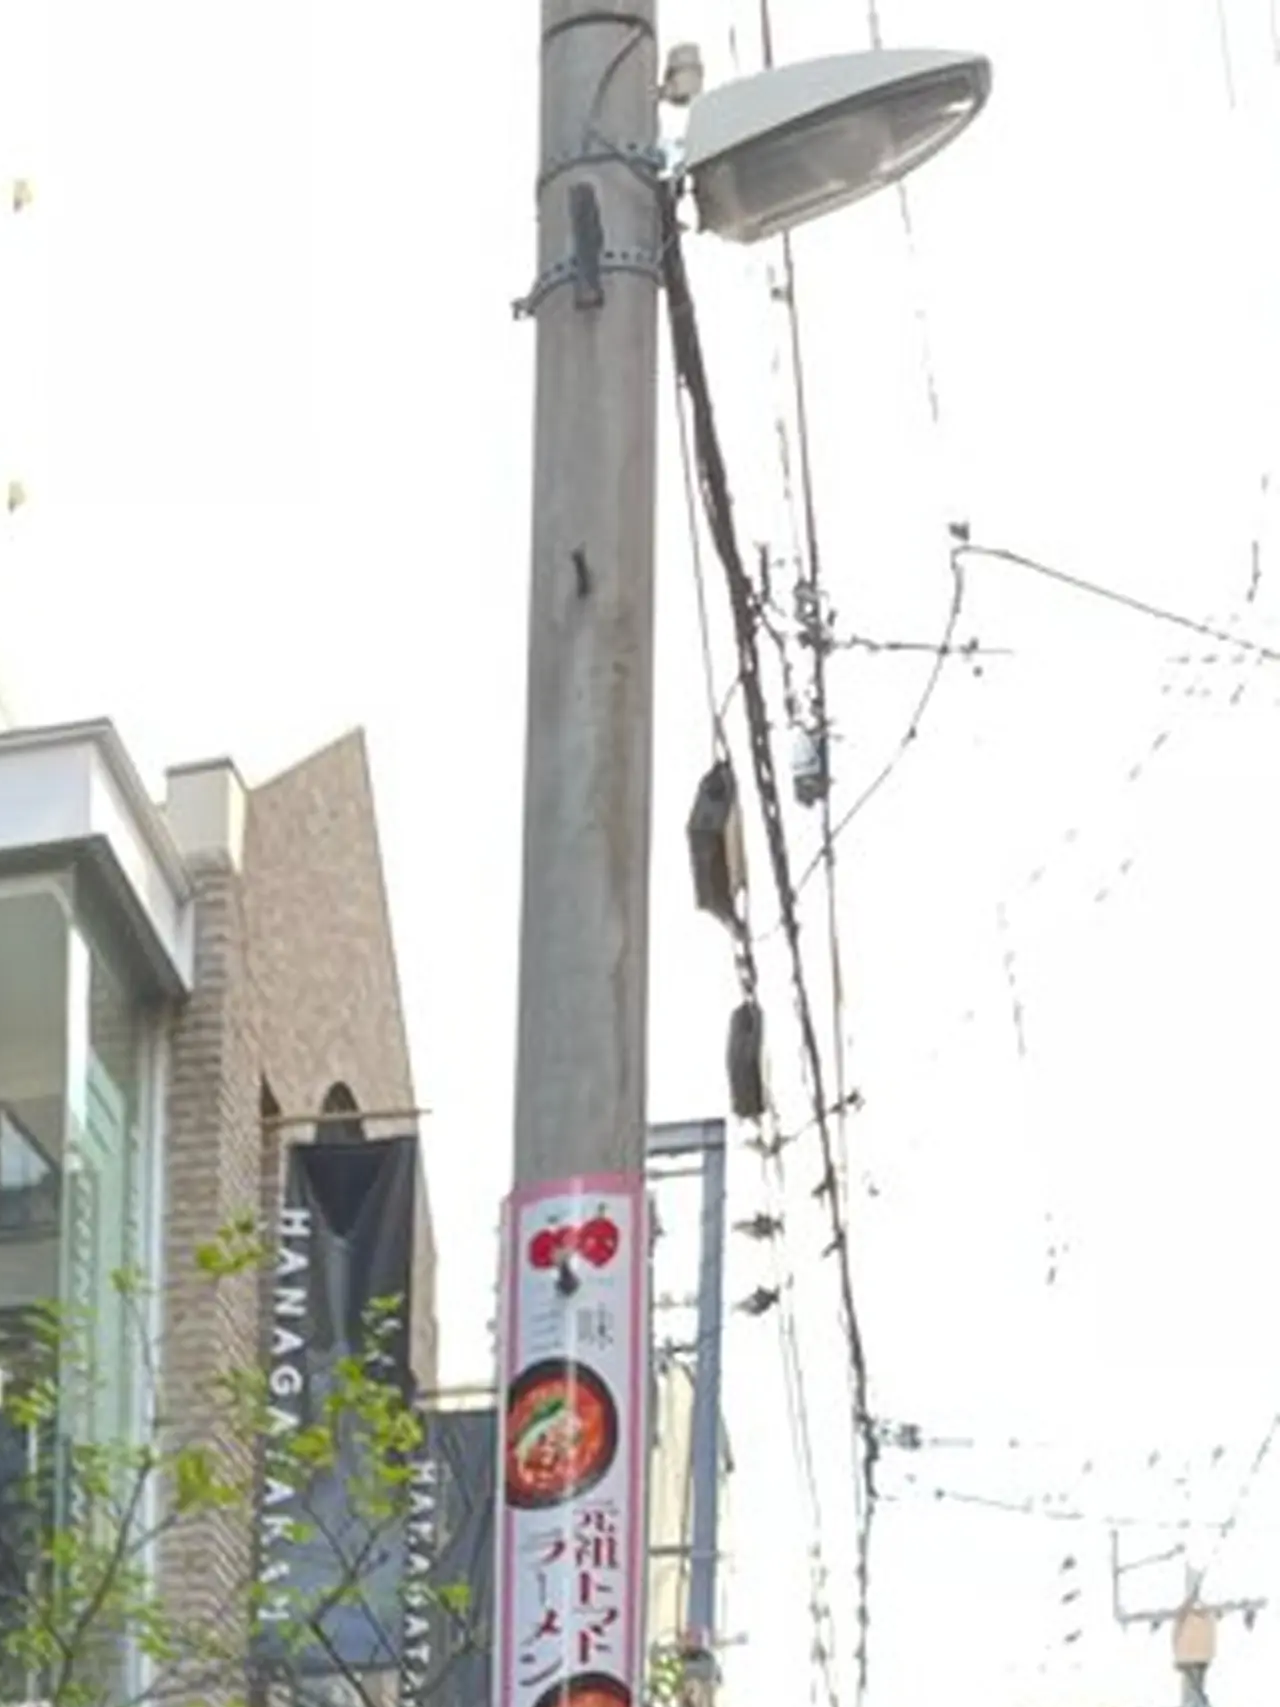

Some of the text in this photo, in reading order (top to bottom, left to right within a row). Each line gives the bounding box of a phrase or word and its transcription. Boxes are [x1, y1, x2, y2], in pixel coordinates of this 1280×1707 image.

[520, 1527, 565, 1686] ラーメン
[572, 1499, 620, 1665] 元祖トマト
